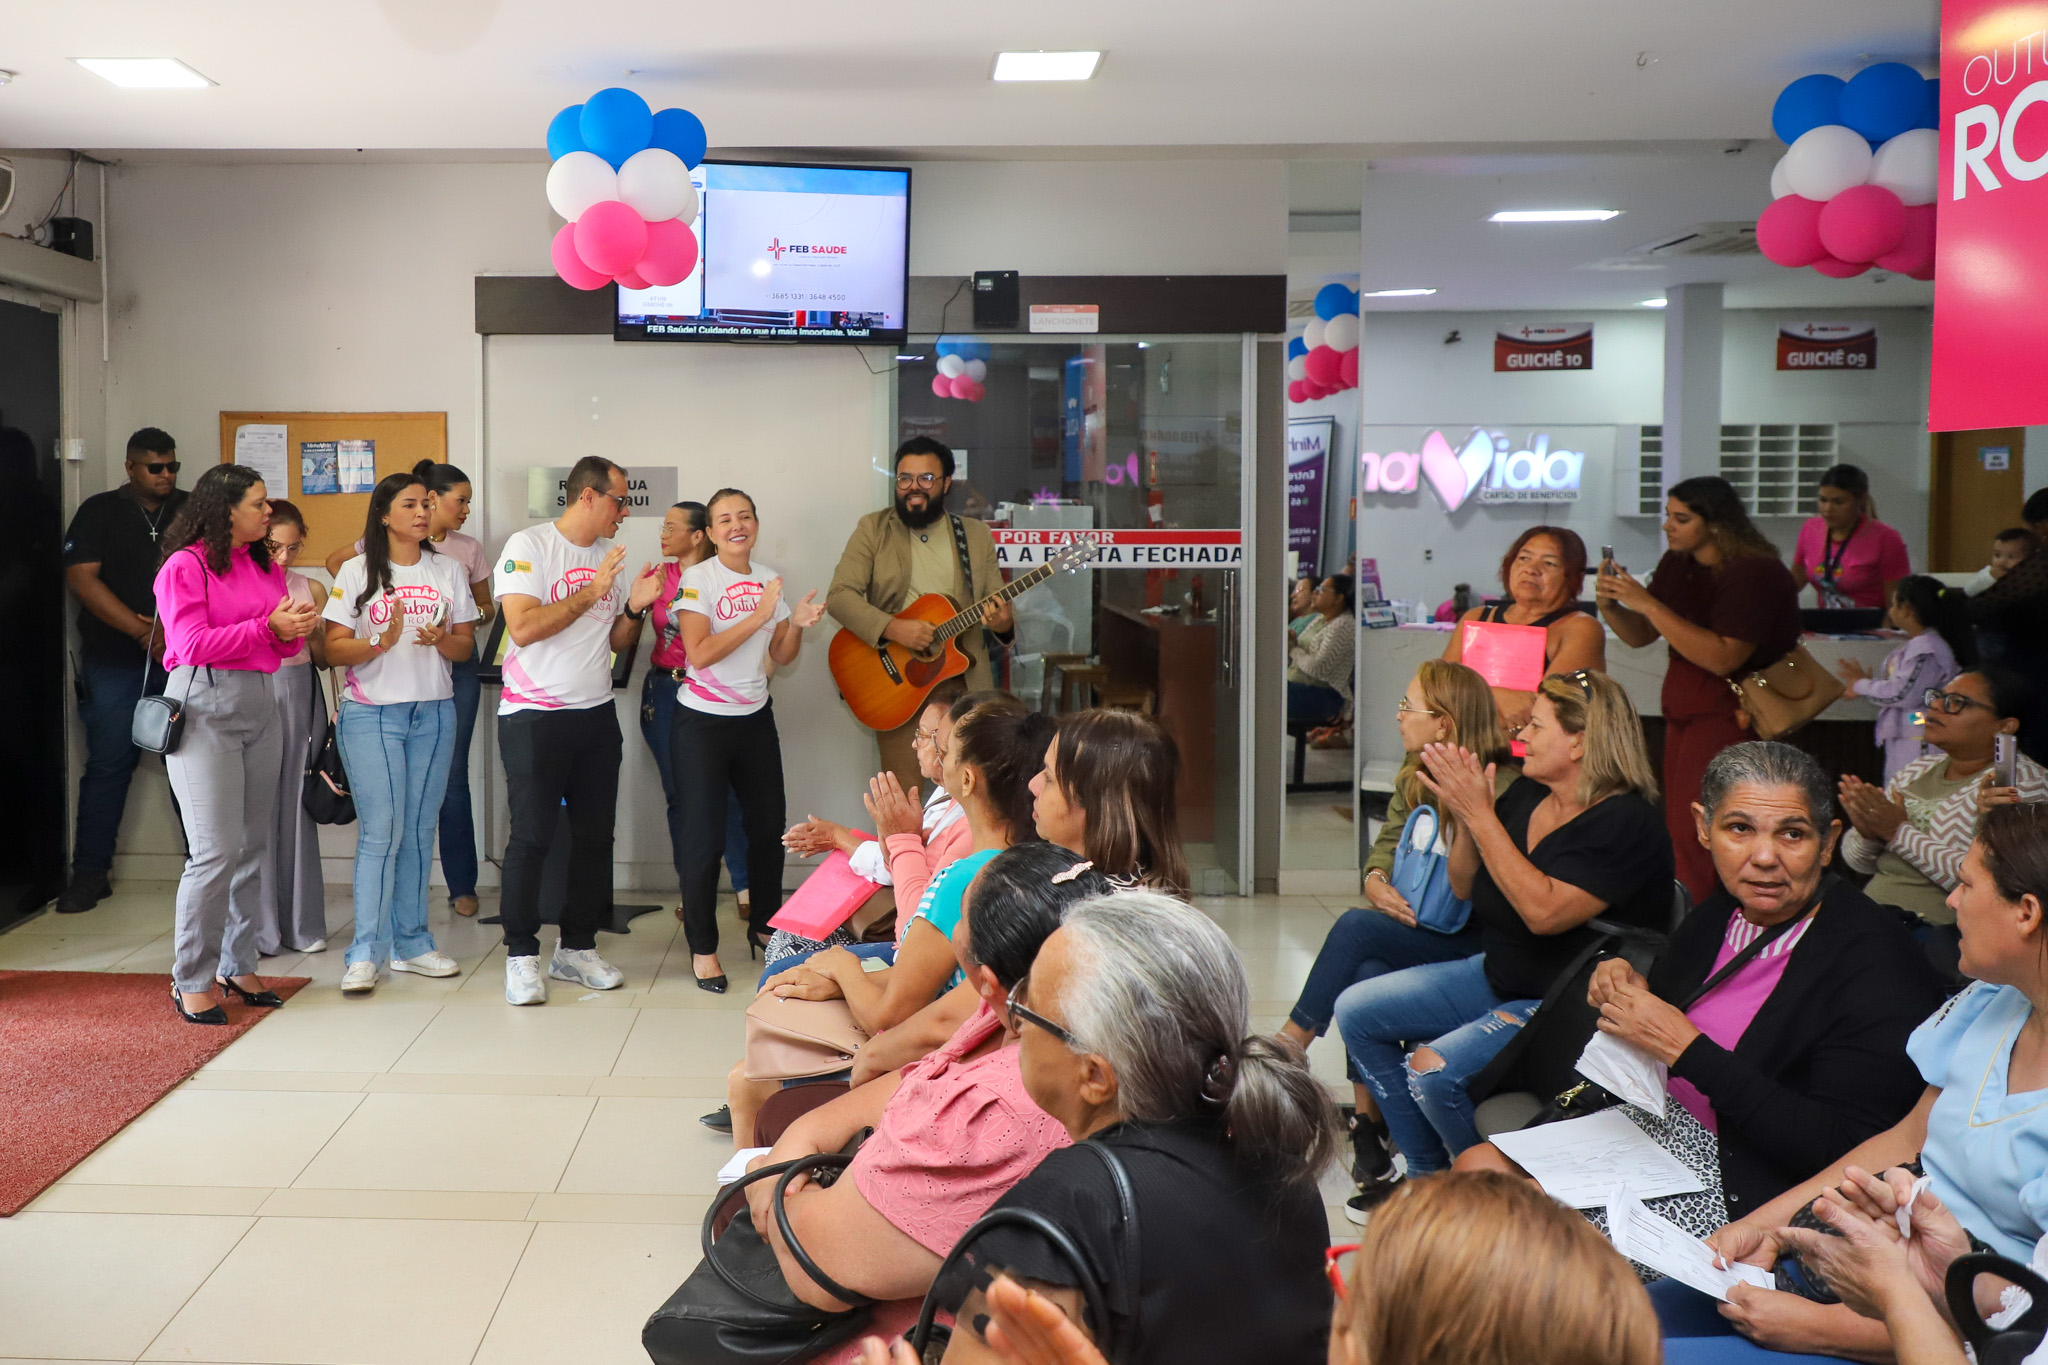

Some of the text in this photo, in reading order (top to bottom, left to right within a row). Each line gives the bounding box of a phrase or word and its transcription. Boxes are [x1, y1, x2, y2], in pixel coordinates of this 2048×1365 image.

[789, 245, 809, 254] FEB
[1033, 317, 1095, 326] LANCHONETE
[646, 325, 666, 333] FEB
[666, 325, 697, 334] Saúde!
[698, 325, 739, 335] Cuidando
[740, 326, 751, 335] do
[770, 327, 777, 335] é
[777, 328, 798, 336] mais
[846, 328, 870, 337] Você!
[1507, 350, 1582, 368] GUICHÊ 10
[1787, 348, 1868, 369] GUICHÊ 09
[627, 480, 648, 490] UA
[1517, 491, 1528, 500] DE
[626, 496, 649, 507] QUI
[1000, 531, 1041, 544] POR
[1019, 546, 1033, 562] A
[1044, 546, 1122, 562] PTA
[1132, 546, 1241, 562] FECHADA
[591, 602, 611, 611] OSA
